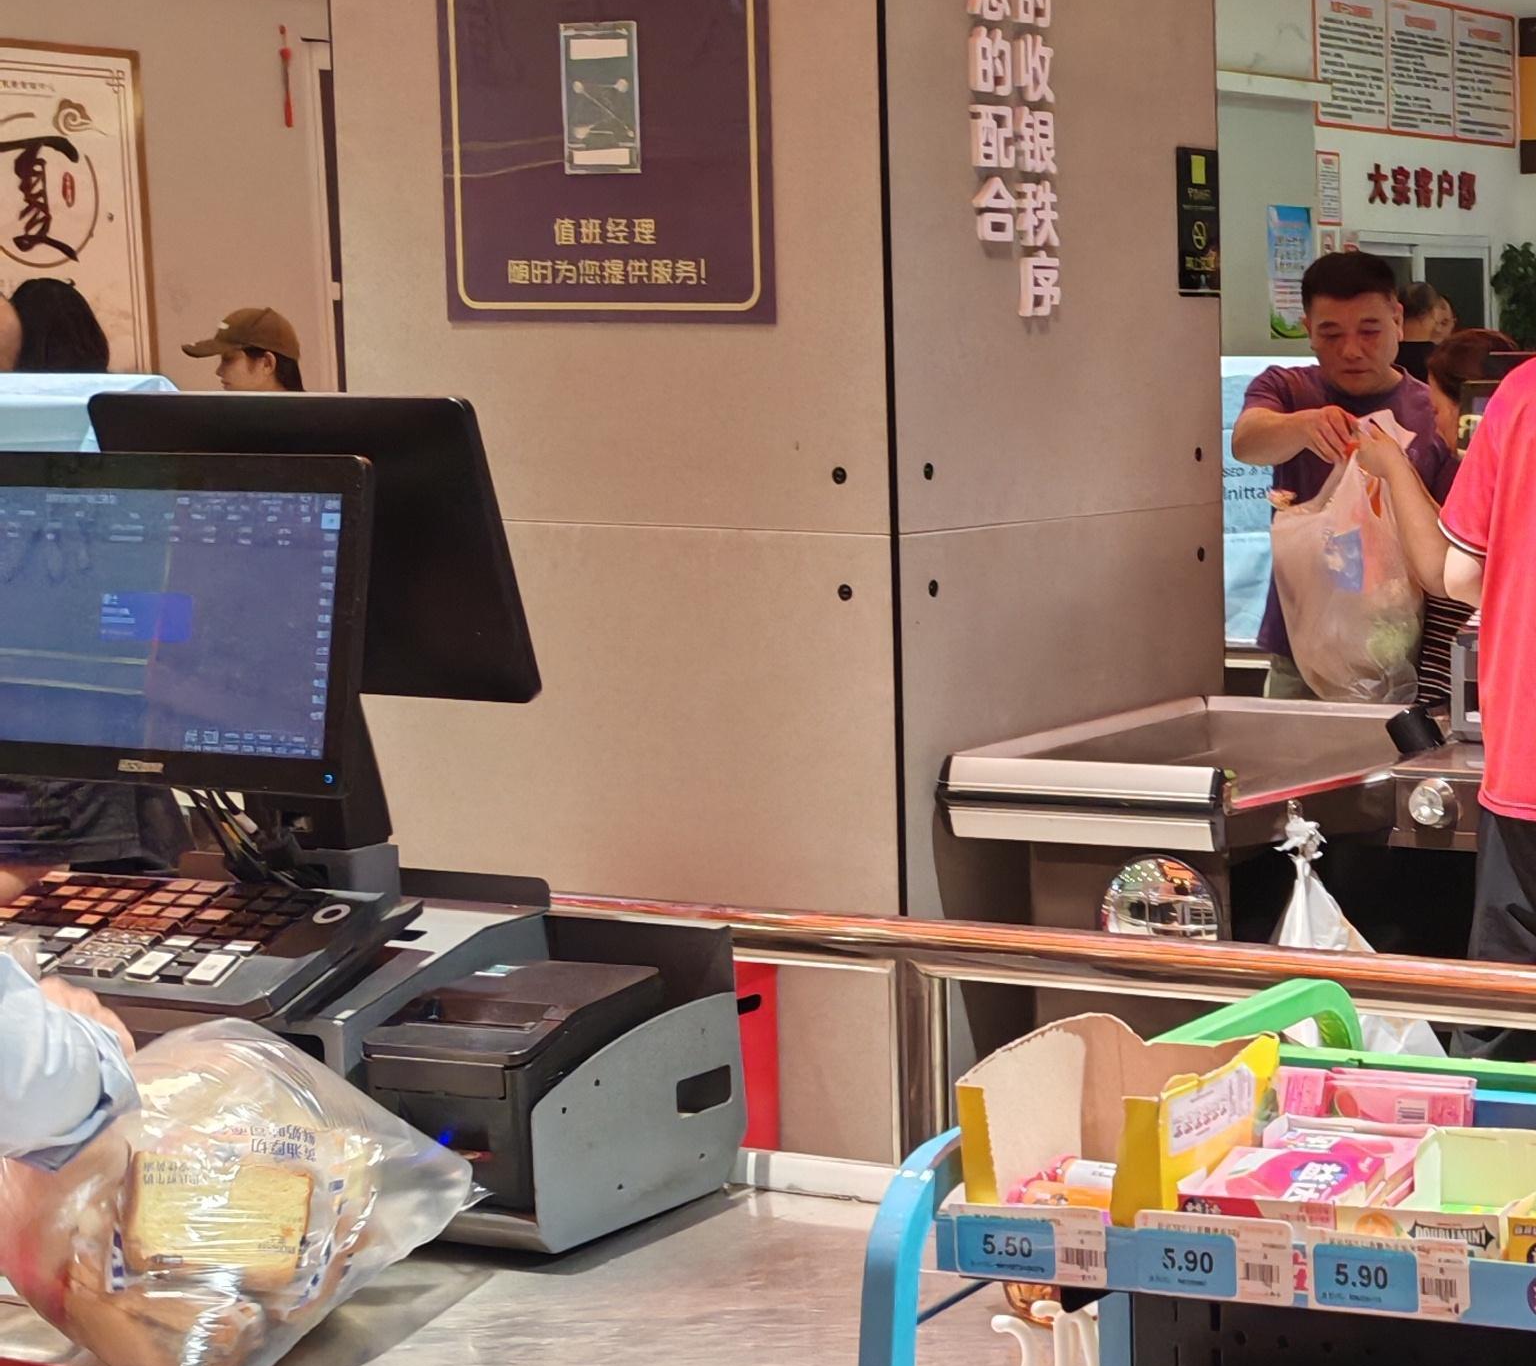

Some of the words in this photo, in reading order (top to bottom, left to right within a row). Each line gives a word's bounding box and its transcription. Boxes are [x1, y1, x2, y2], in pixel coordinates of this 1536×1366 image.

[554, 217, 657, 246] 值班经理
[981, 1232, 1033, 1259] 5.50
[1161, 1247, 1215, 1275] 5.90
[1334, 1262, 1389, 1290] 5.90
